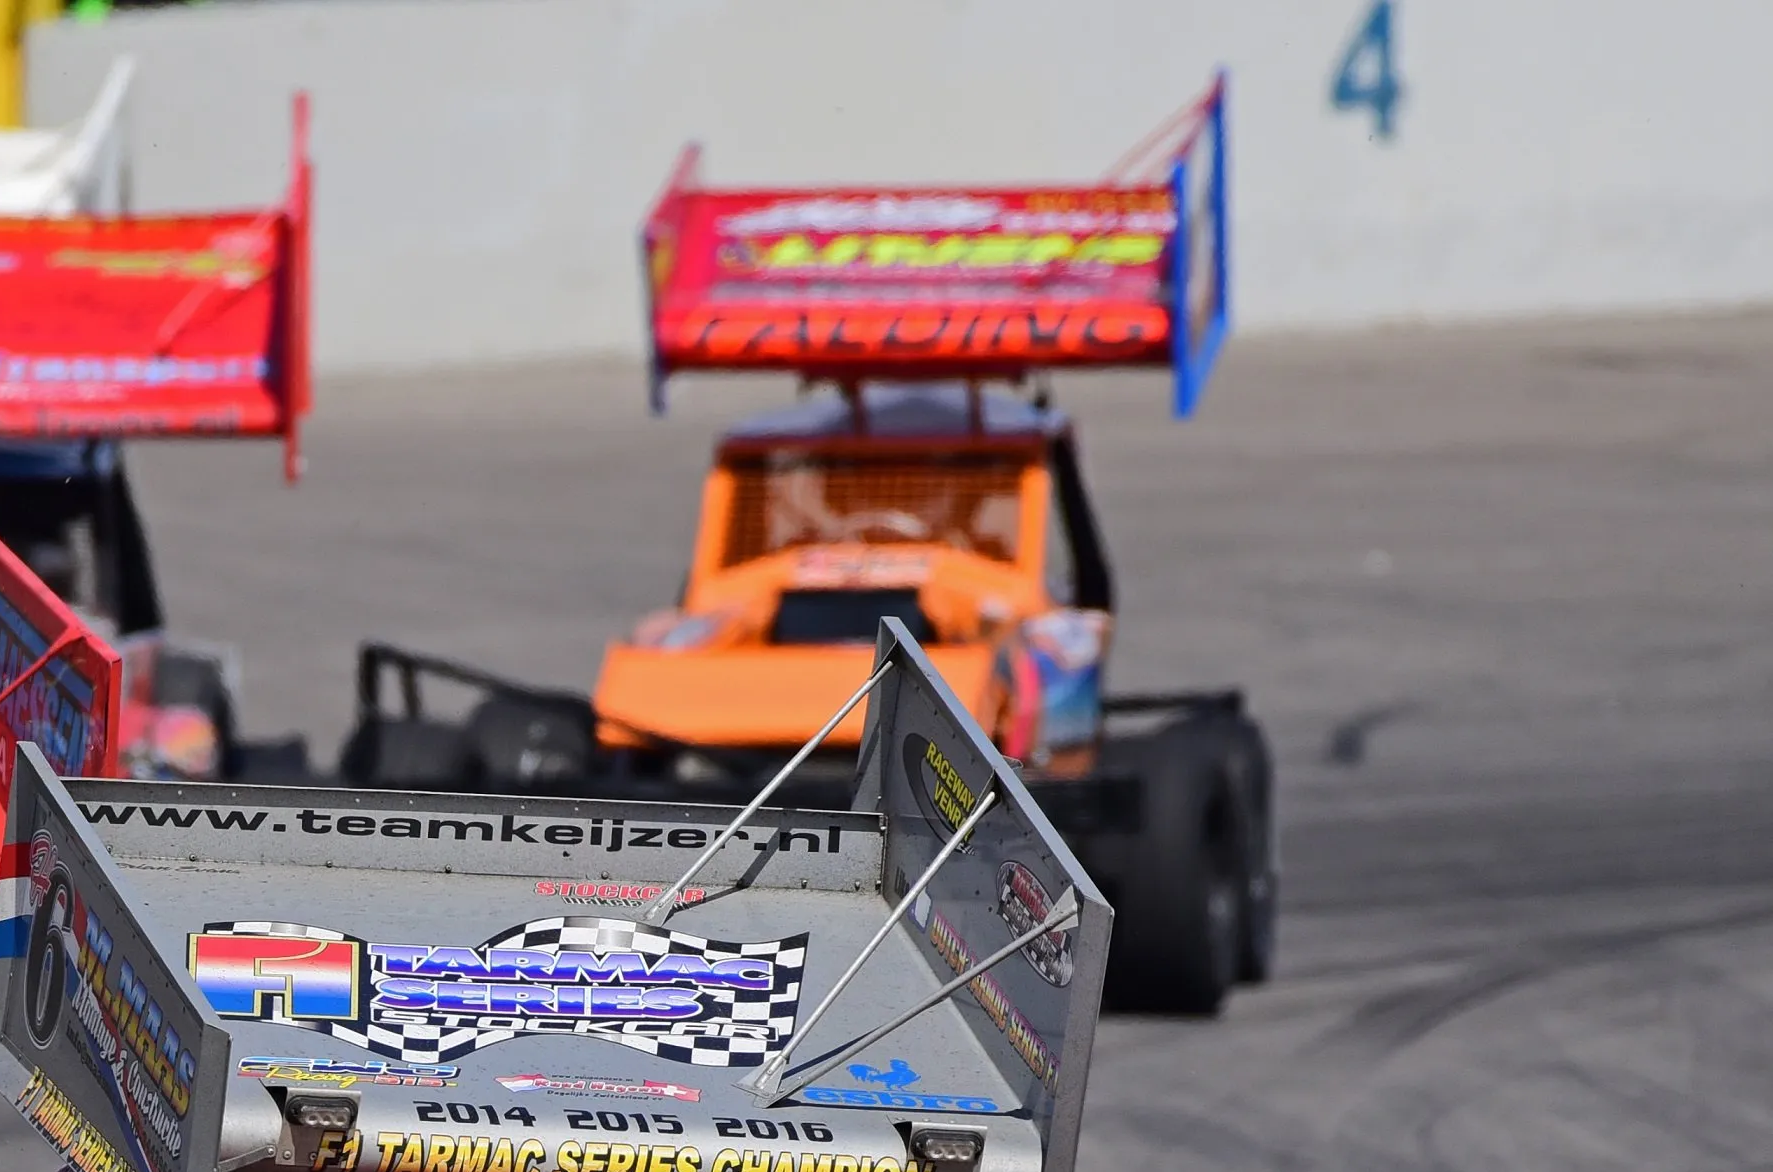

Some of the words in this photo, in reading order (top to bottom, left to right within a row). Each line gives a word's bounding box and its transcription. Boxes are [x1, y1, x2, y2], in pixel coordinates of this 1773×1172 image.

[1332, 0, 1400, 136] 4
[926, 740, 975, 816] RACEWAY
[78, 804, 840, 854] www.teamkeijzer.nl
[935, 780, 975, 842] VENR
[25, 868, 74, 1050] 6
[367, 944, 774, 992] TARMAC
[373, 976, 706, 1020] SERIES
[373, 1011, 779, 1042] STOCKCAR
[412, 1100, 537, 1128] 2014
[563, 1109, 684, 1135] 2015
[710, 1115, 834, 1143] 2016
